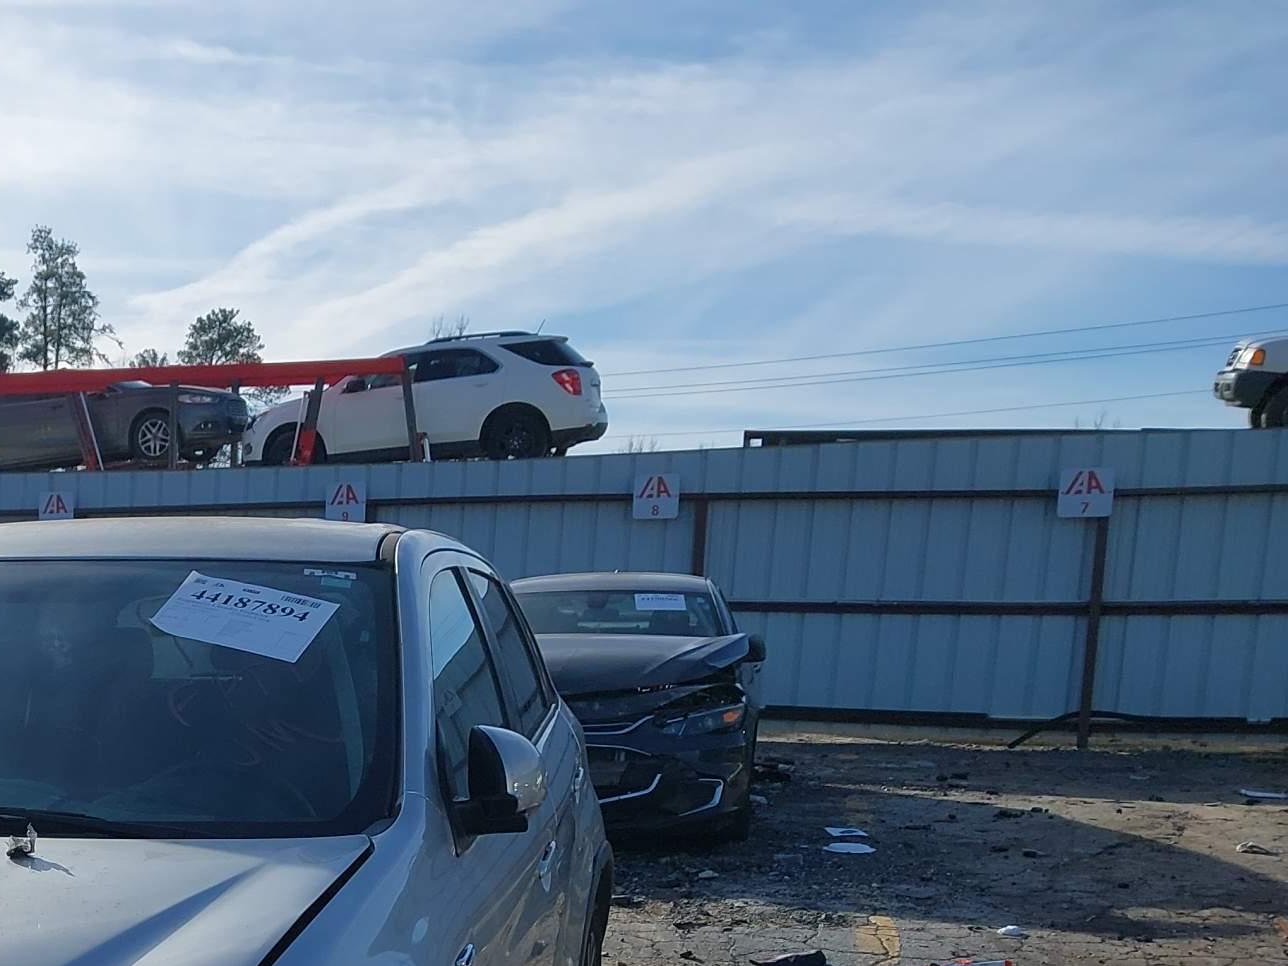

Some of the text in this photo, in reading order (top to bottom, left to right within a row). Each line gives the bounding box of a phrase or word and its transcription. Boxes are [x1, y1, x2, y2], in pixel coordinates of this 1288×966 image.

[651, 504, 660, 516] 8
[1080, 501, 1090, 514] 7
[342, 511, 349, 521] 9
[191, 589, 311, 622] 44187894
